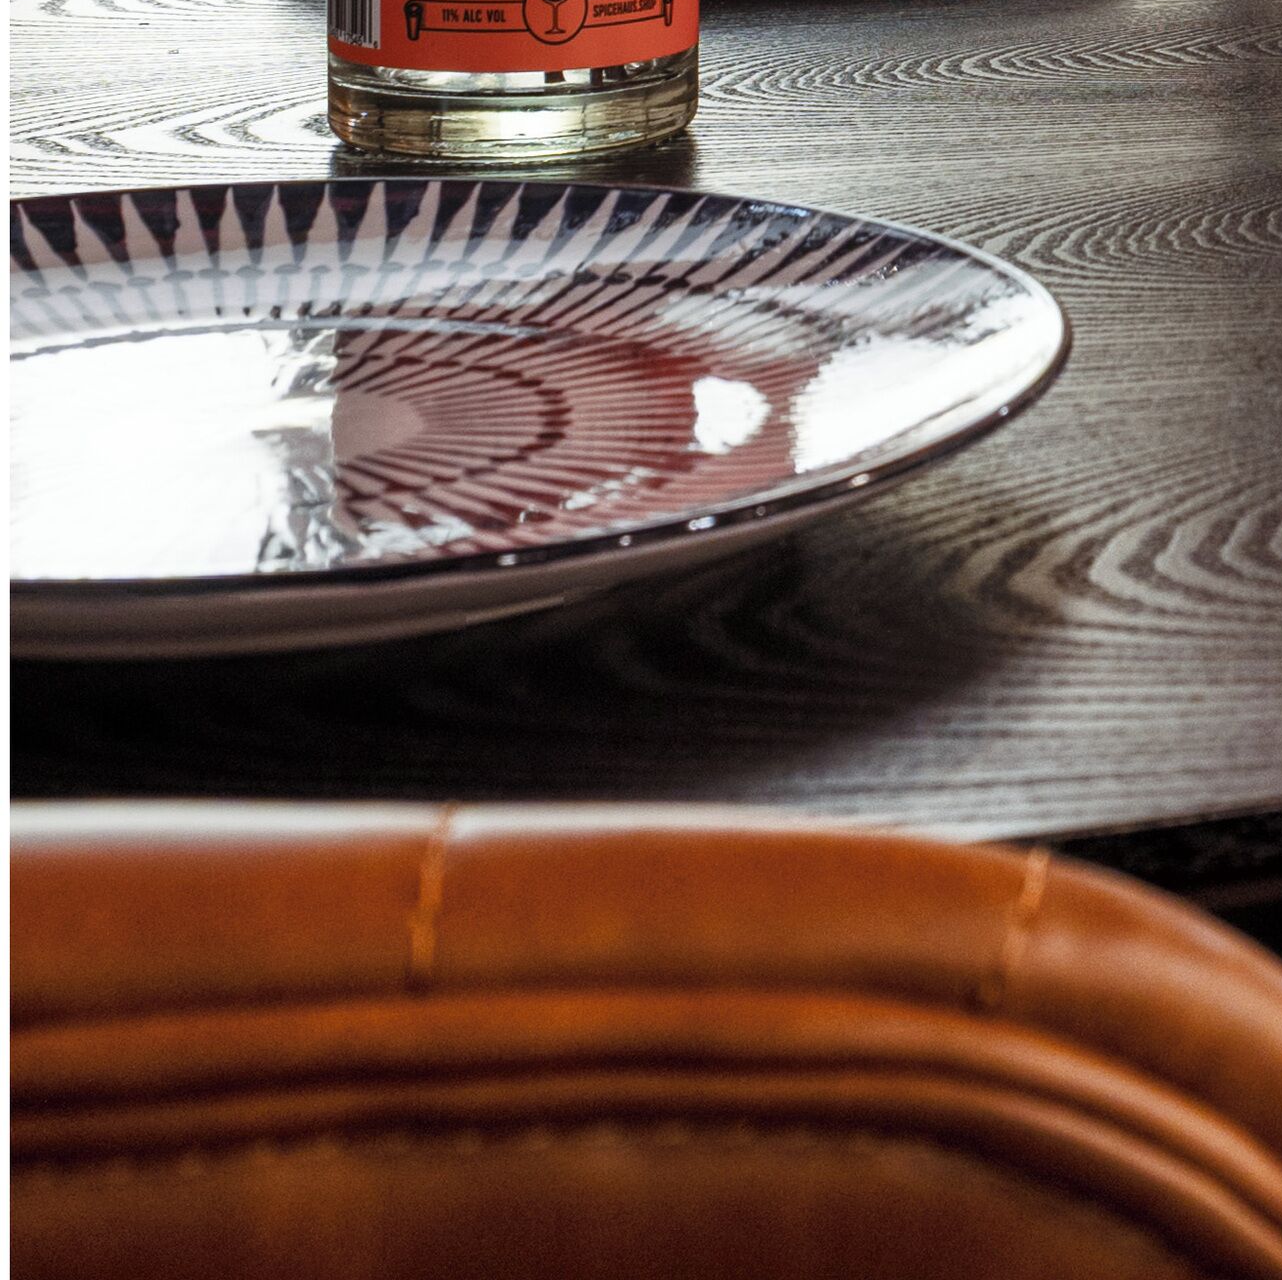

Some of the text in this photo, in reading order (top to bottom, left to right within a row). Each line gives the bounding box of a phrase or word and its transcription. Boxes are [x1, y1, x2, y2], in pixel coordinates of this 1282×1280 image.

[442, 8, 506, 23] 11% ALC VOL
